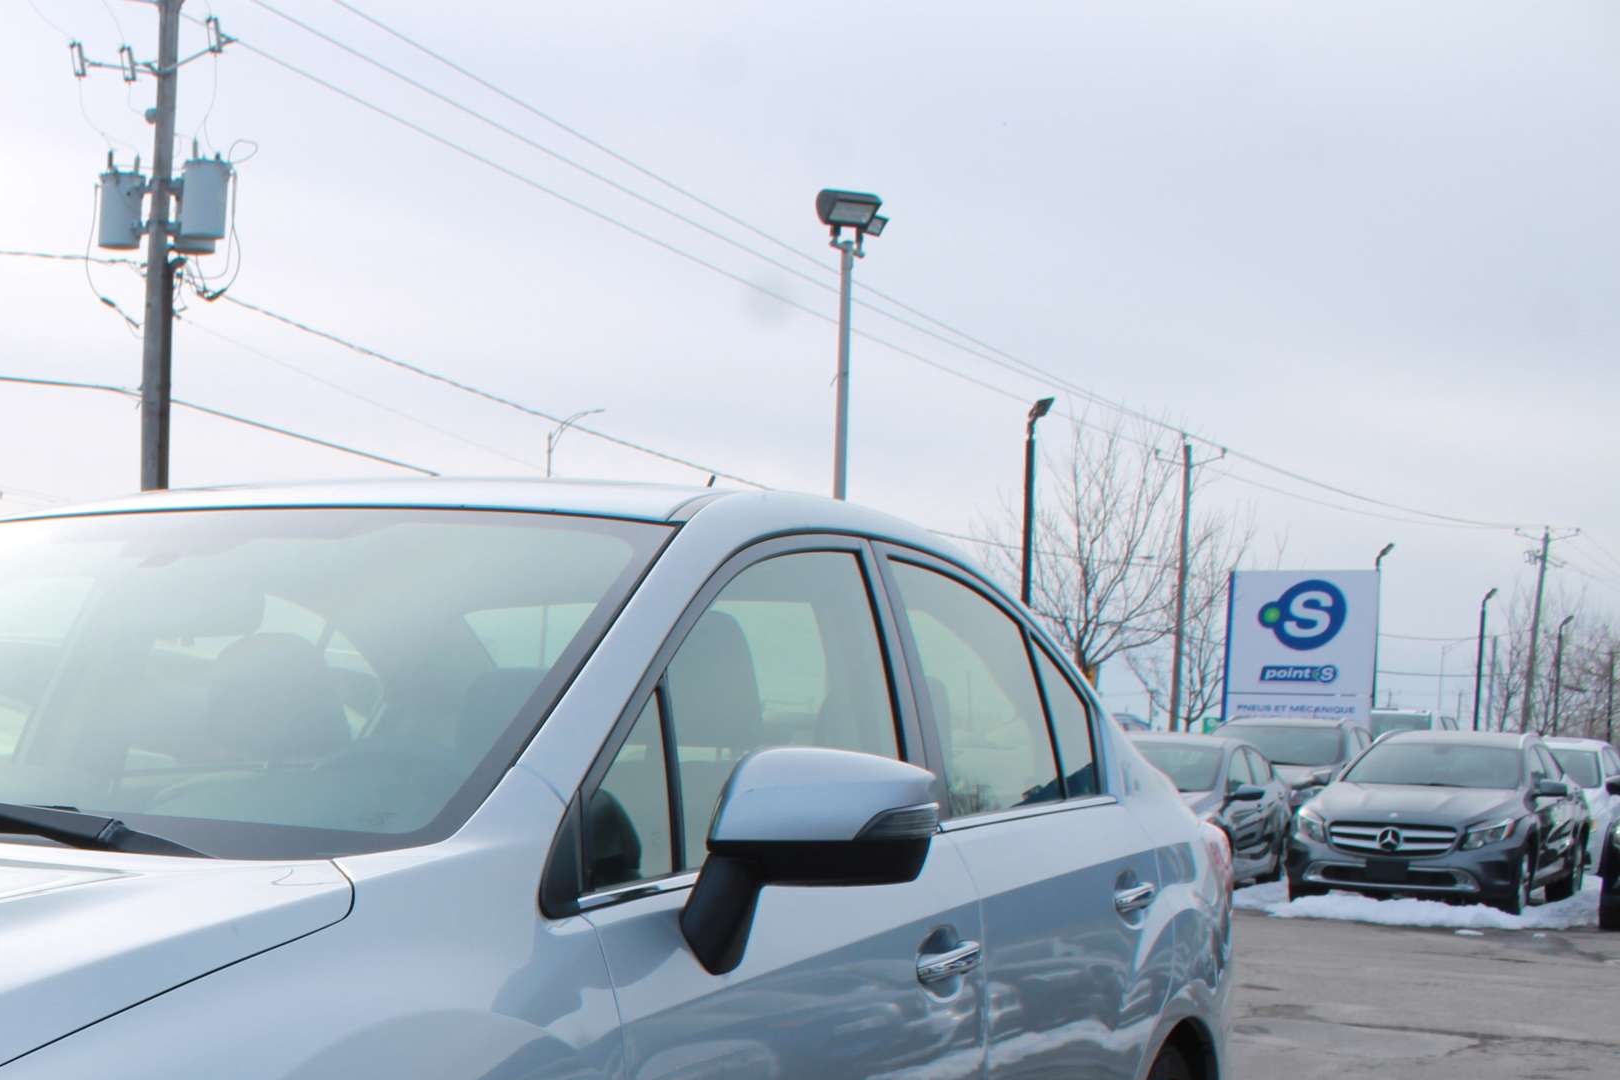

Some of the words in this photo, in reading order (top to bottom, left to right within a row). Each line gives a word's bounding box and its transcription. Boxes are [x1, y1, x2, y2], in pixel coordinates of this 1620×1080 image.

[1284, 591, 1333, 638] S
[1265, 668, 1311, 680] point
[1237, 704, 1272, 713] PNEUS
[1274, 704, 1288, 713] ET
